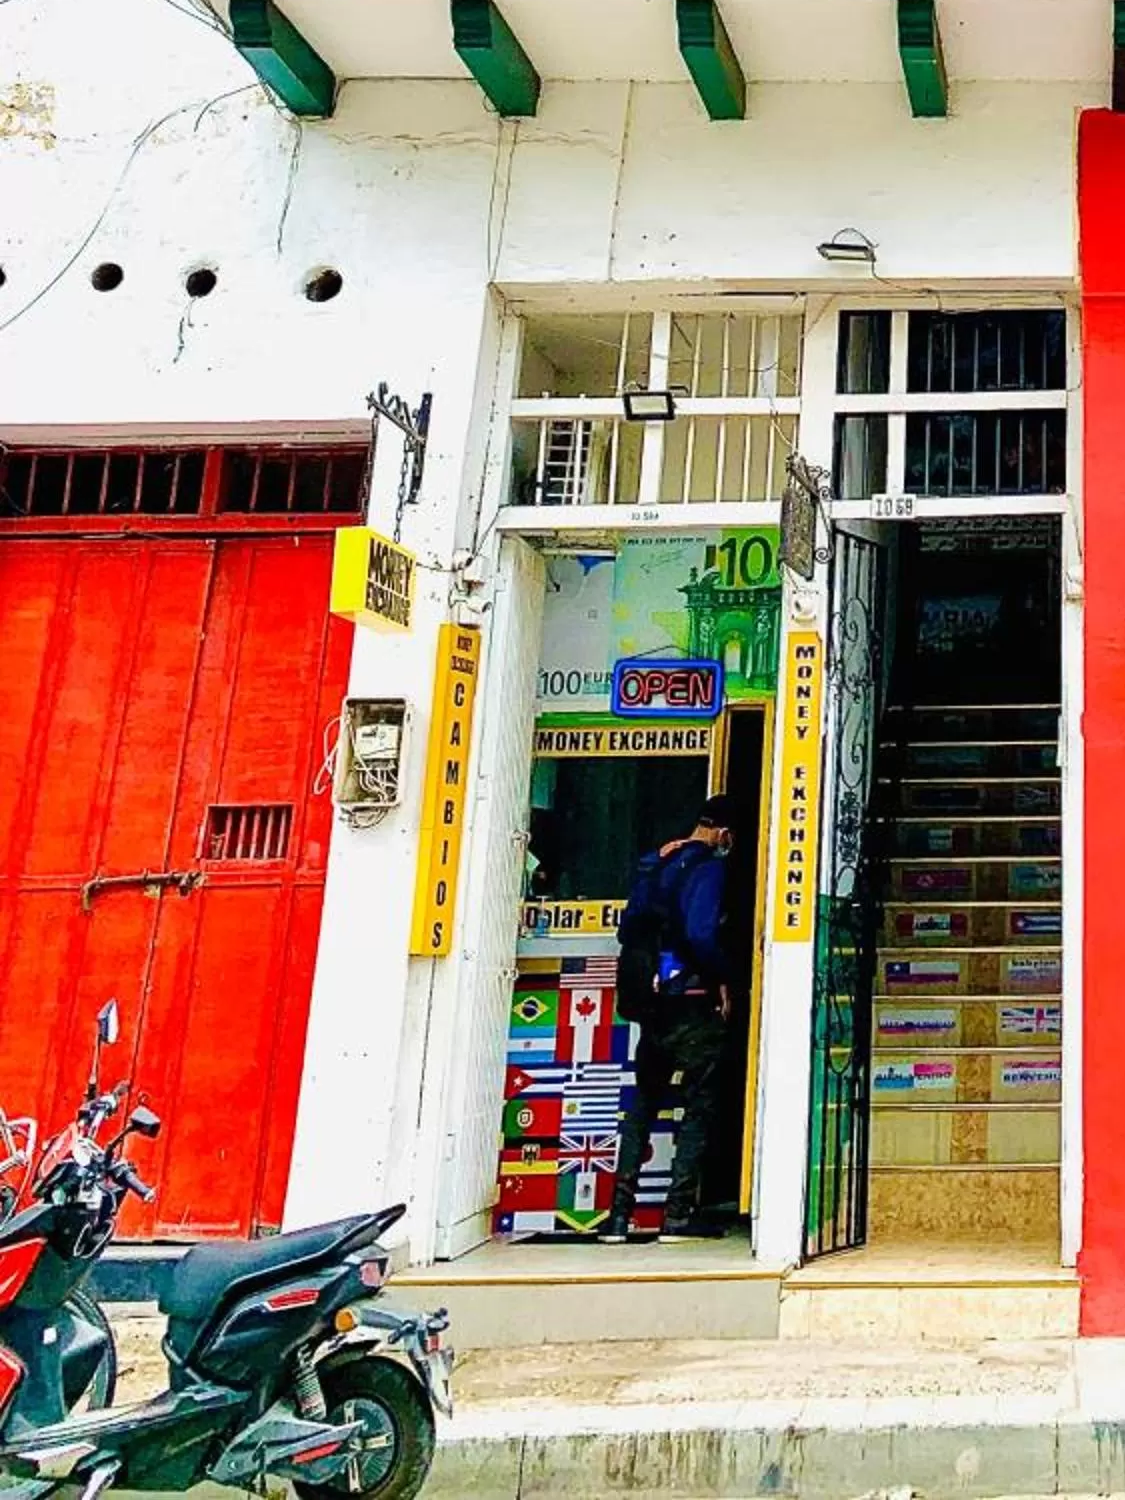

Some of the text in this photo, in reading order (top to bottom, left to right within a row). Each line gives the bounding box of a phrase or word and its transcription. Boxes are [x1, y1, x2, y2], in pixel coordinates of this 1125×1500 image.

[719, 535, 782, 587] 10
[540, 670, 582, 695] 100
[620, 670, 713, 706] OPEN
[537, 729, 709, 751] MONEY EXCHANGE
[785, 645, 816, 927] MONEY EXCHANGE
[431, 681, 466, 949] CAMBIOS
[601, 904, 624, 927] Eu
